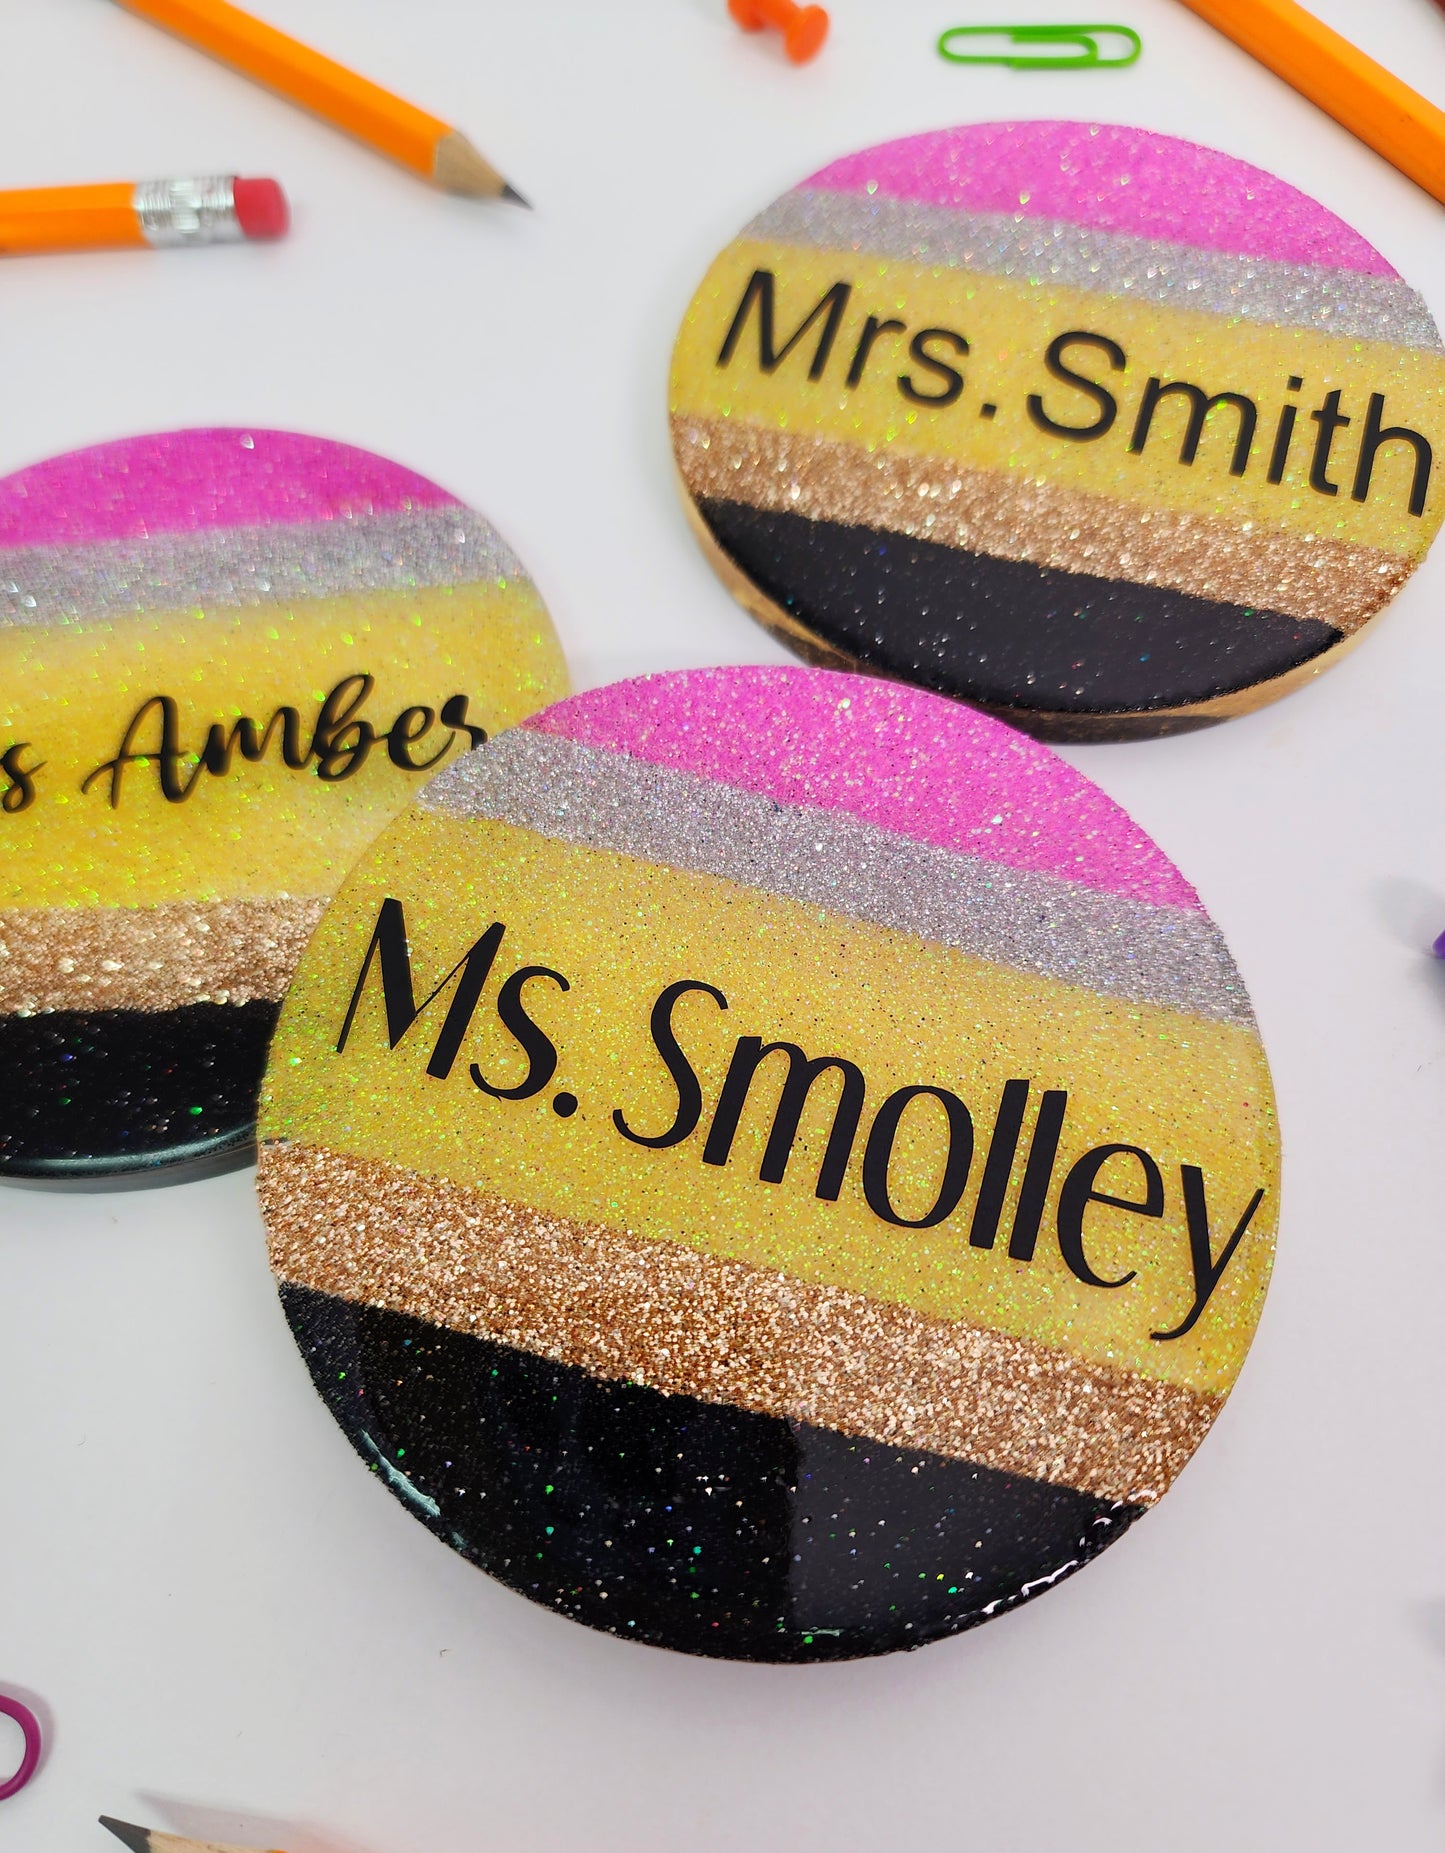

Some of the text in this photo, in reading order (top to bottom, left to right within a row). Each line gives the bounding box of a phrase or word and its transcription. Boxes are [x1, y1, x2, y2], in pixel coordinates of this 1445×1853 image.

[81, 673, 489, 809] Amber
[336, 897, 1265, 1342] Ms. Smolley
